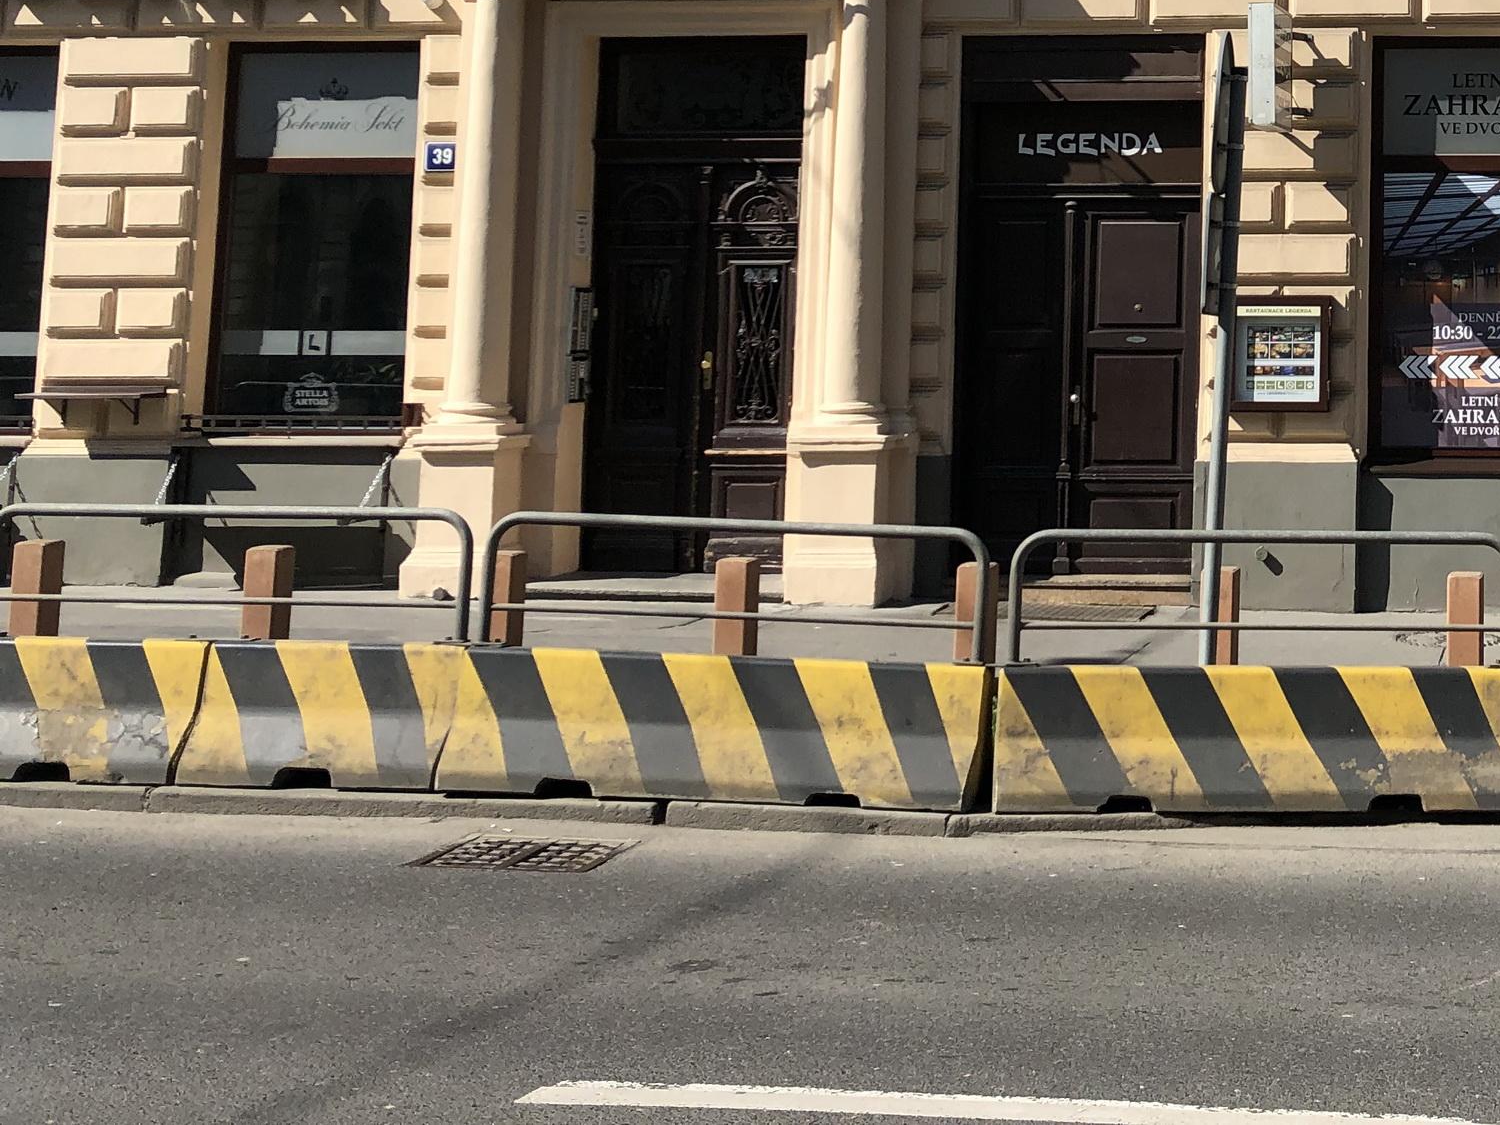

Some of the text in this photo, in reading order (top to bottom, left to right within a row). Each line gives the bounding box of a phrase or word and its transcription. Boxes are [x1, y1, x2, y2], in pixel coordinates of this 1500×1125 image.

[270, 103, 406, 132] Bohemia Sekt
[1440, 122, 1461, 134] VE
[1018, 132, 1163, 156] LEGENDA
[432, 148, 453, 164] 39
[1433, 325, 1473, 339] 10:30
[295, 389, 328, 397] STELLA
[294, 398, 329, 406] ARTOIS
[1461, 394, 1498, 407] LETNÍ
[1454, 426, 1468, 436] VE
